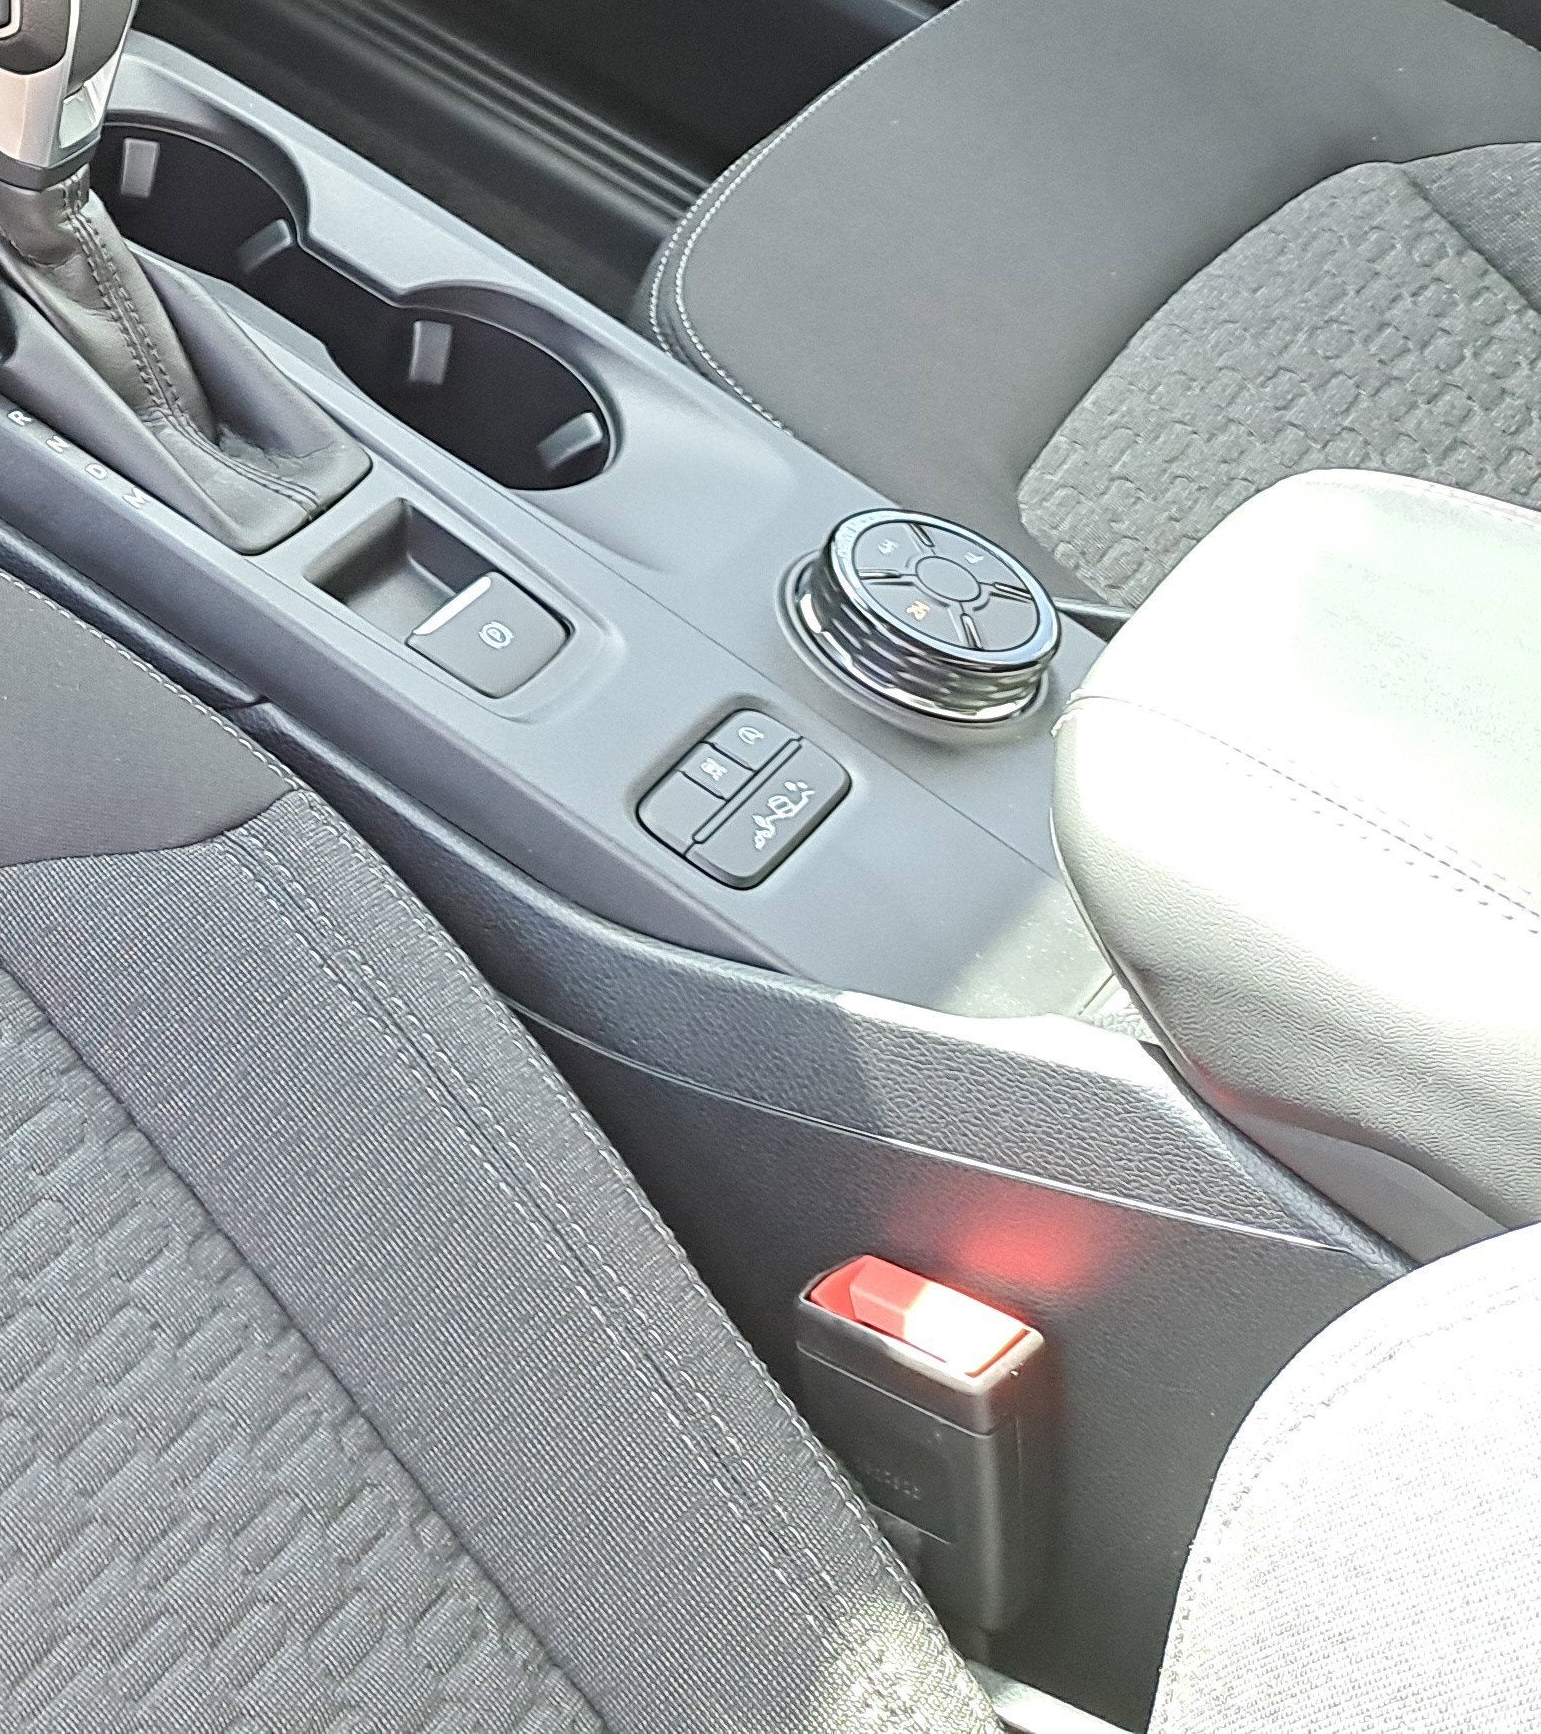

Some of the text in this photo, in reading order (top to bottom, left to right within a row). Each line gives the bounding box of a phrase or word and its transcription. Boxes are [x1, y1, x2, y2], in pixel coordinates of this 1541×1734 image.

[7, 410, 32, 426] R
[46, 435, 70, 453] N
[85, 463, 107, 480] D
[123, 488, 152, 509] M
